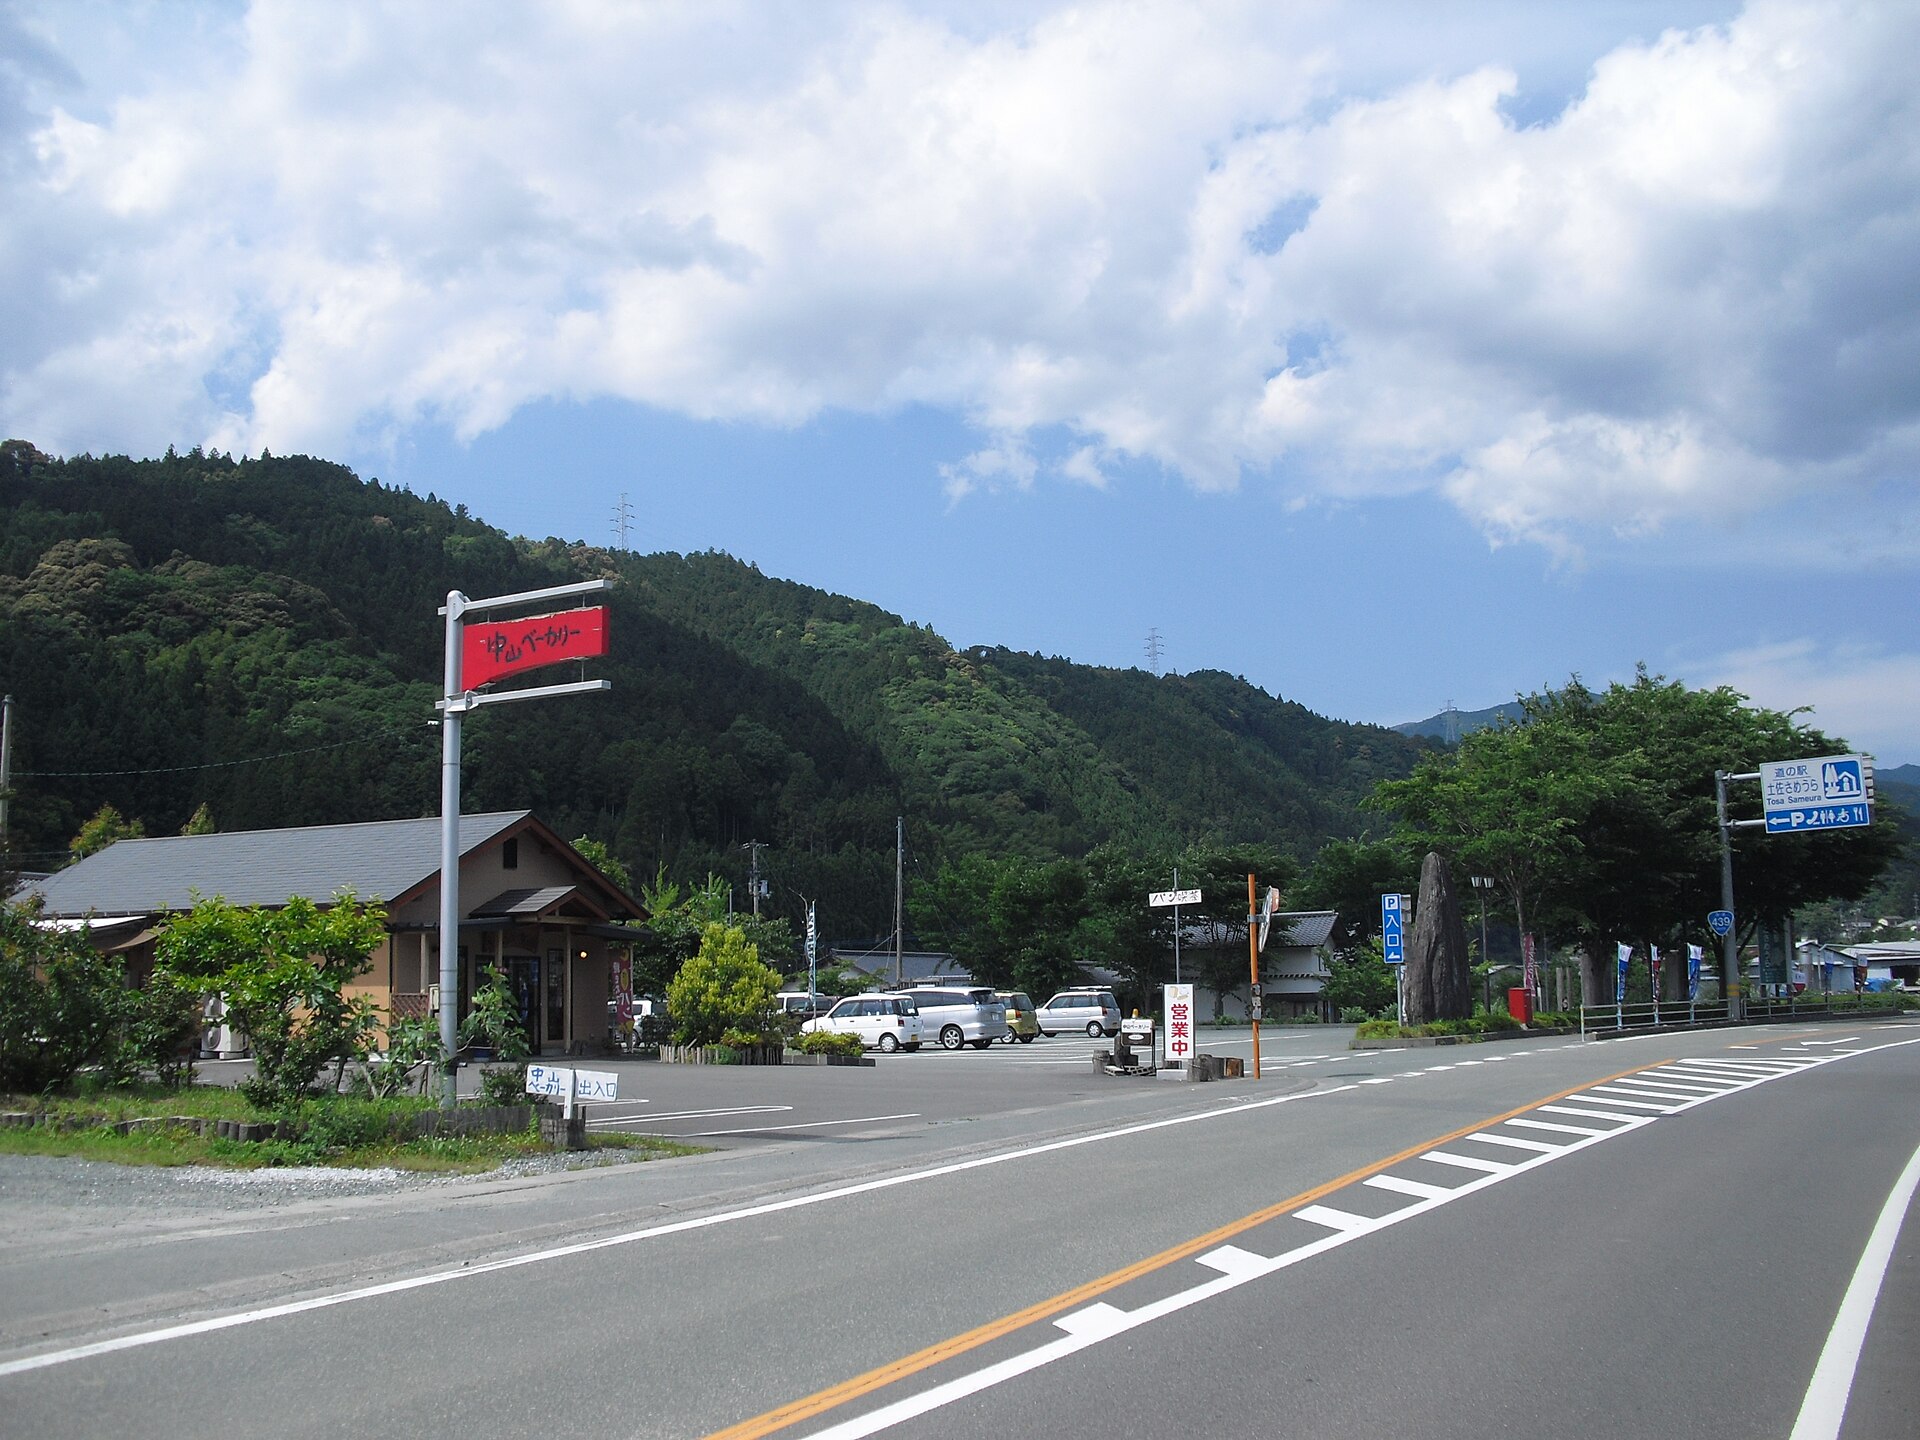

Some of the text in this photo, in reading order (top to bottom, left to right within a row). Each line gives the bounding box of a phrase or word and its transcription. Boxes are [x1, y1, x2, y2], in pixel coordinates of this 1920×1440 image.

[1774, 765, 1808, 778] 道の駅
[1767, 779, 1818, 796] 土佐さめうら
[1766, 795, 1822, 806] Tosa Sameura
[1791, 811, 1805, 827] P
[1387, 898, 1396, 908] P
[1712, 916, 1730, 927] 439
[1385, 914, 1399, 947] 入口
[1170, 1003, 1189, 1056] 営業中
[531, 1067, 560, 1083] 中山
[528, 1081, 566, 1095] ベーカリー
[578, 1079, 617, 1098] 出入口
